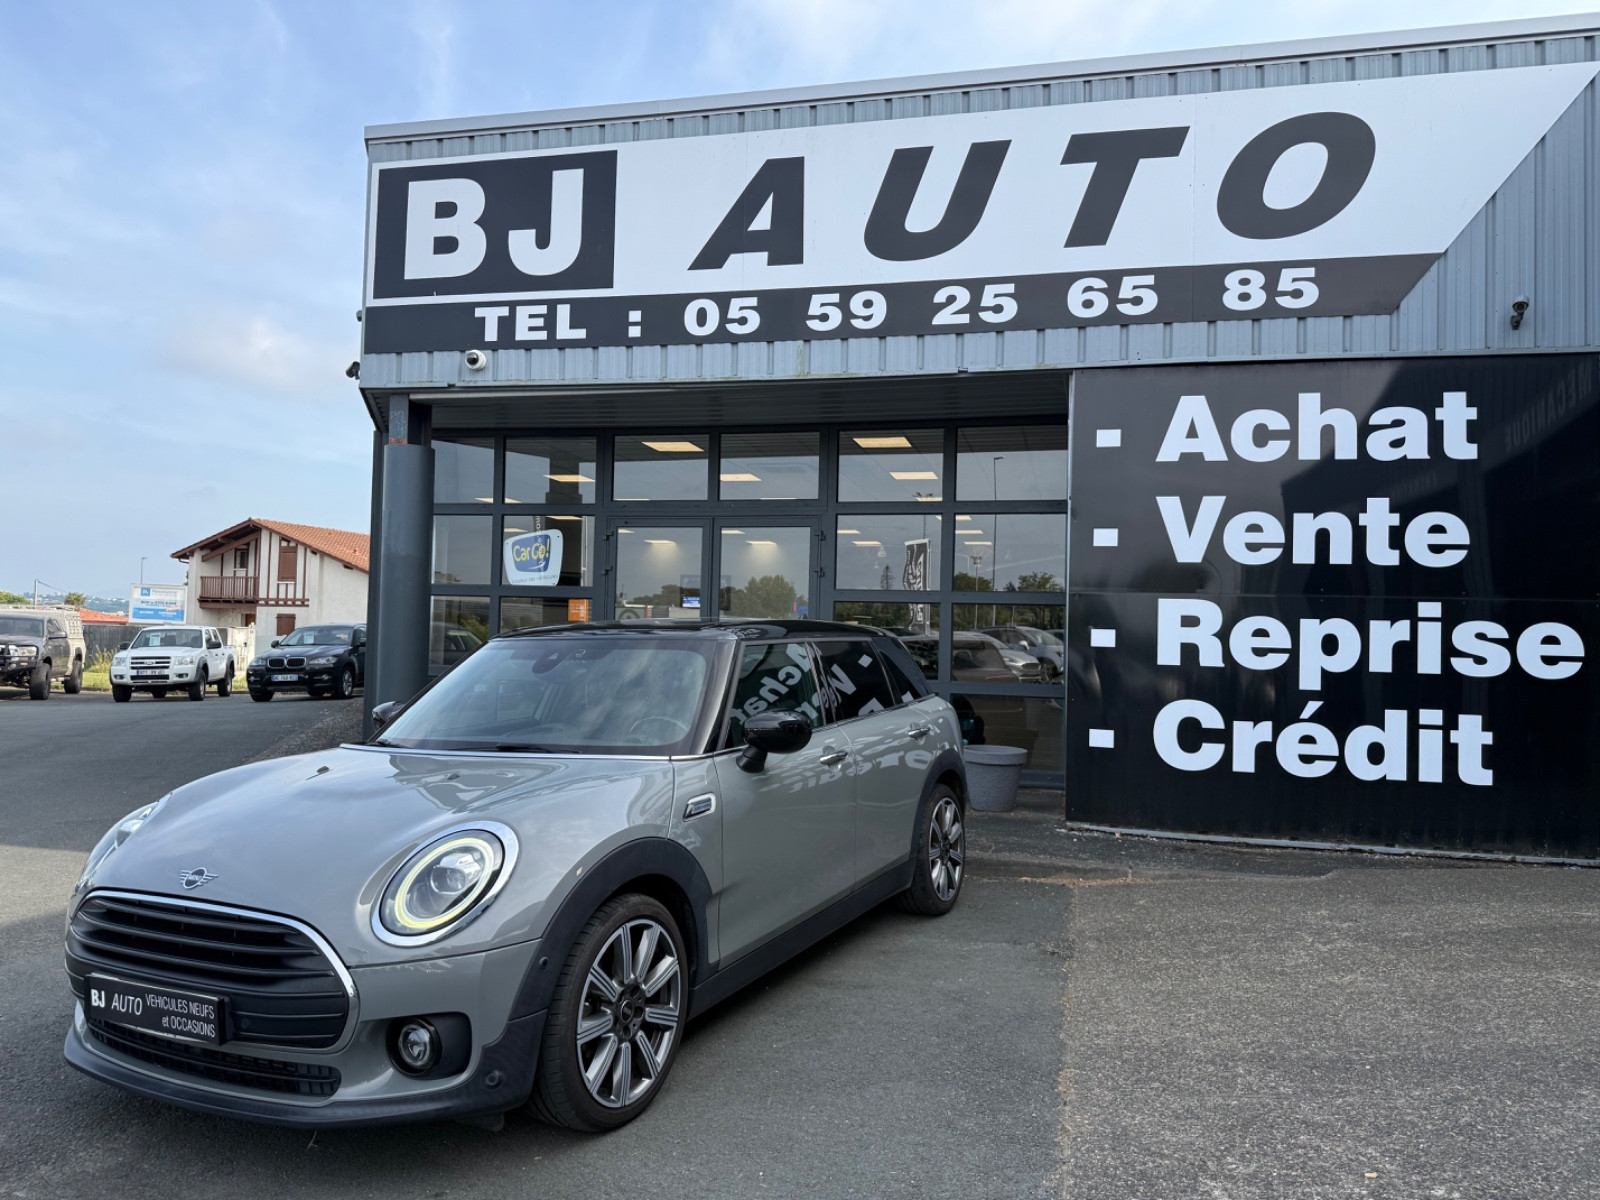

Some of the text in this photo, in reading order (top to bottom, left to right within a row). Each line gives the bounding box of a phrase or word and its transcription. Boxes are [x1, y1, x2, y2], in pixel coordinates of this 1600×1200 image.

[403, 112, 1376, 280] BJ AUTO
[474, 303, 587, 342] TEL
[683, 297, 761, 337] 05
[805, 290, 887, 332] 59
[931, 283, 1018, 326] 25
[1066, 275, 1159, 319] 65
[1222, 266, 1320, 311] 85
[1155, 391, 1478, 463] Achat
[1155, 495, 1470, 568] Vente
[1156, 598, 1585, 691] Reprise
[1153, 699, 1493, 786] Crédit
[91, 988, 215, 1020] BJ AUTO VEHICULES NEUFS
[161, 1015, 216, 1038] et OCCASIONS
